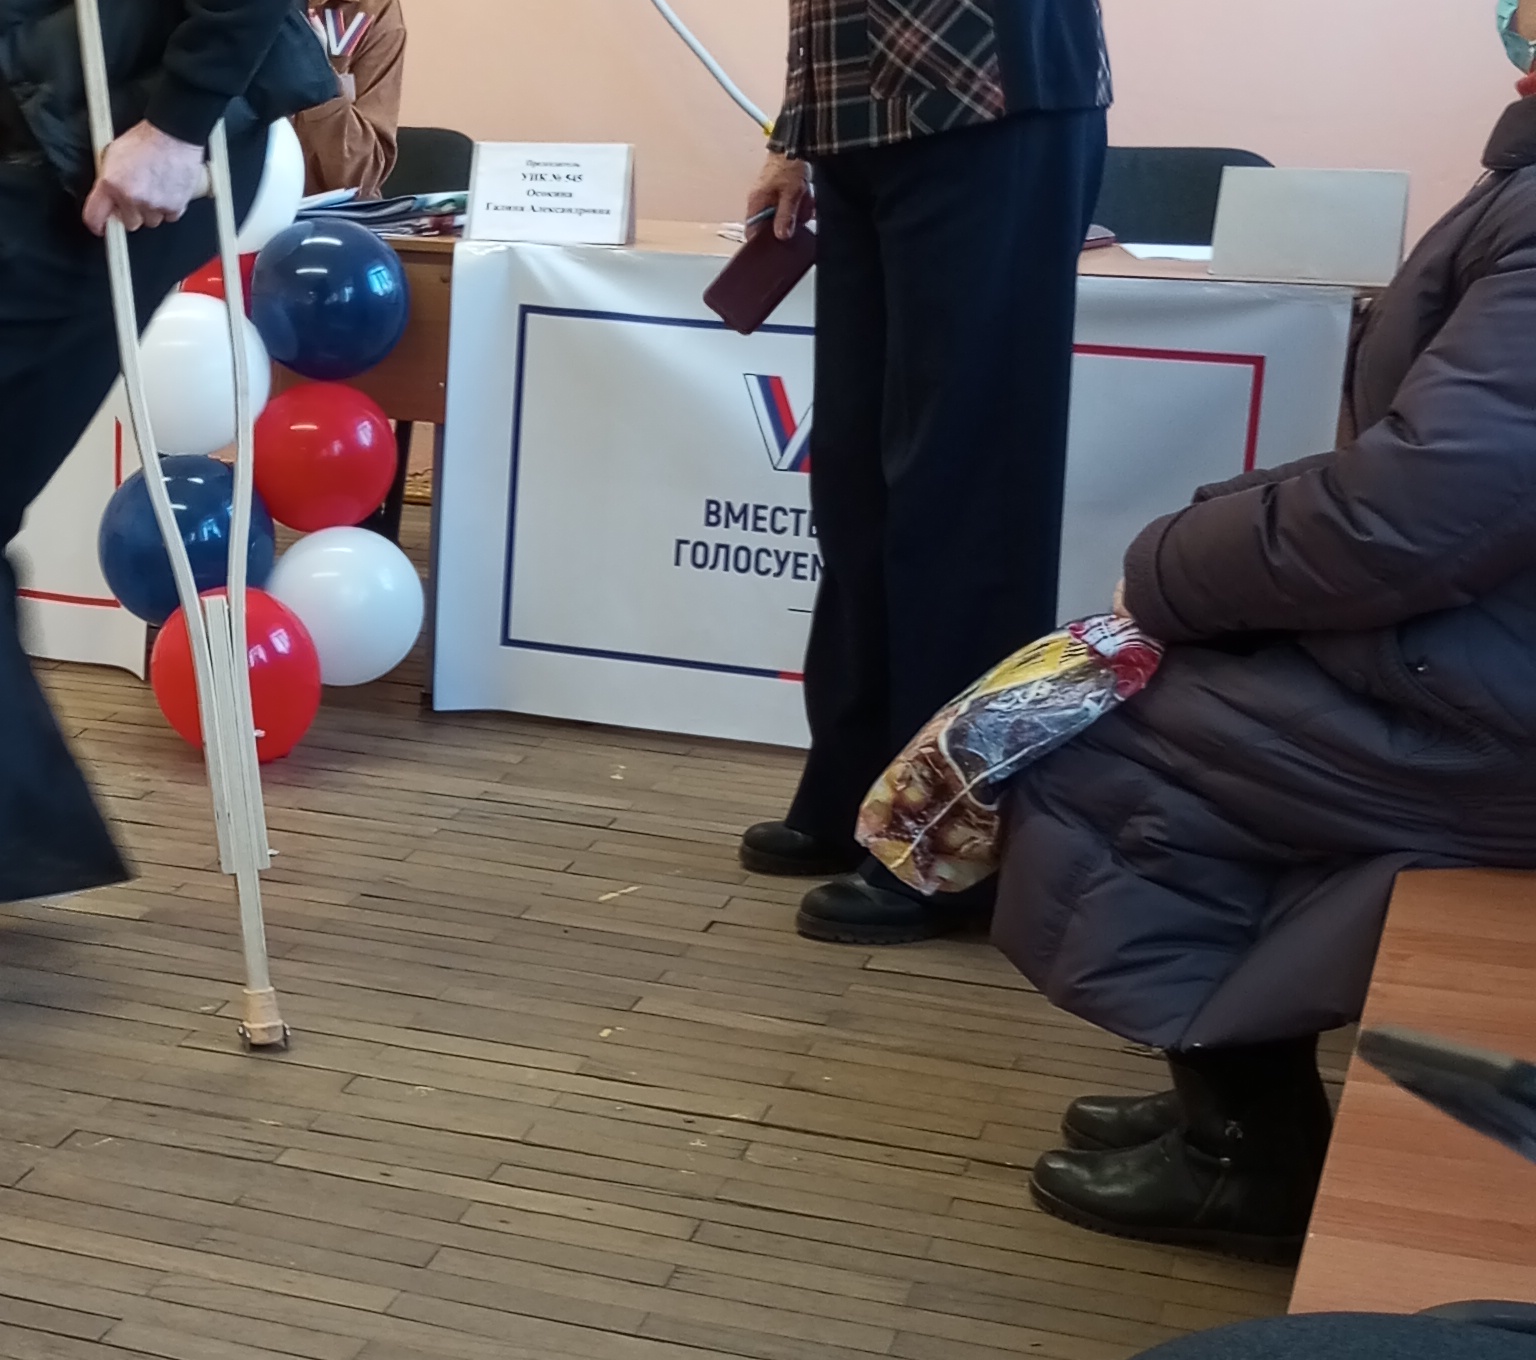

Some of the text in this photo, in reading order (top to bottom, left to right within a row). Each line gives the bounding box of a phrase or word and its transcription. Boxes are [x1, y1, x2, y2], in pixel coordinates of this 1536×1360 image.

[521, 172, 548, 182] УИК
[485, 202, 611, 217] Галина Александровна
